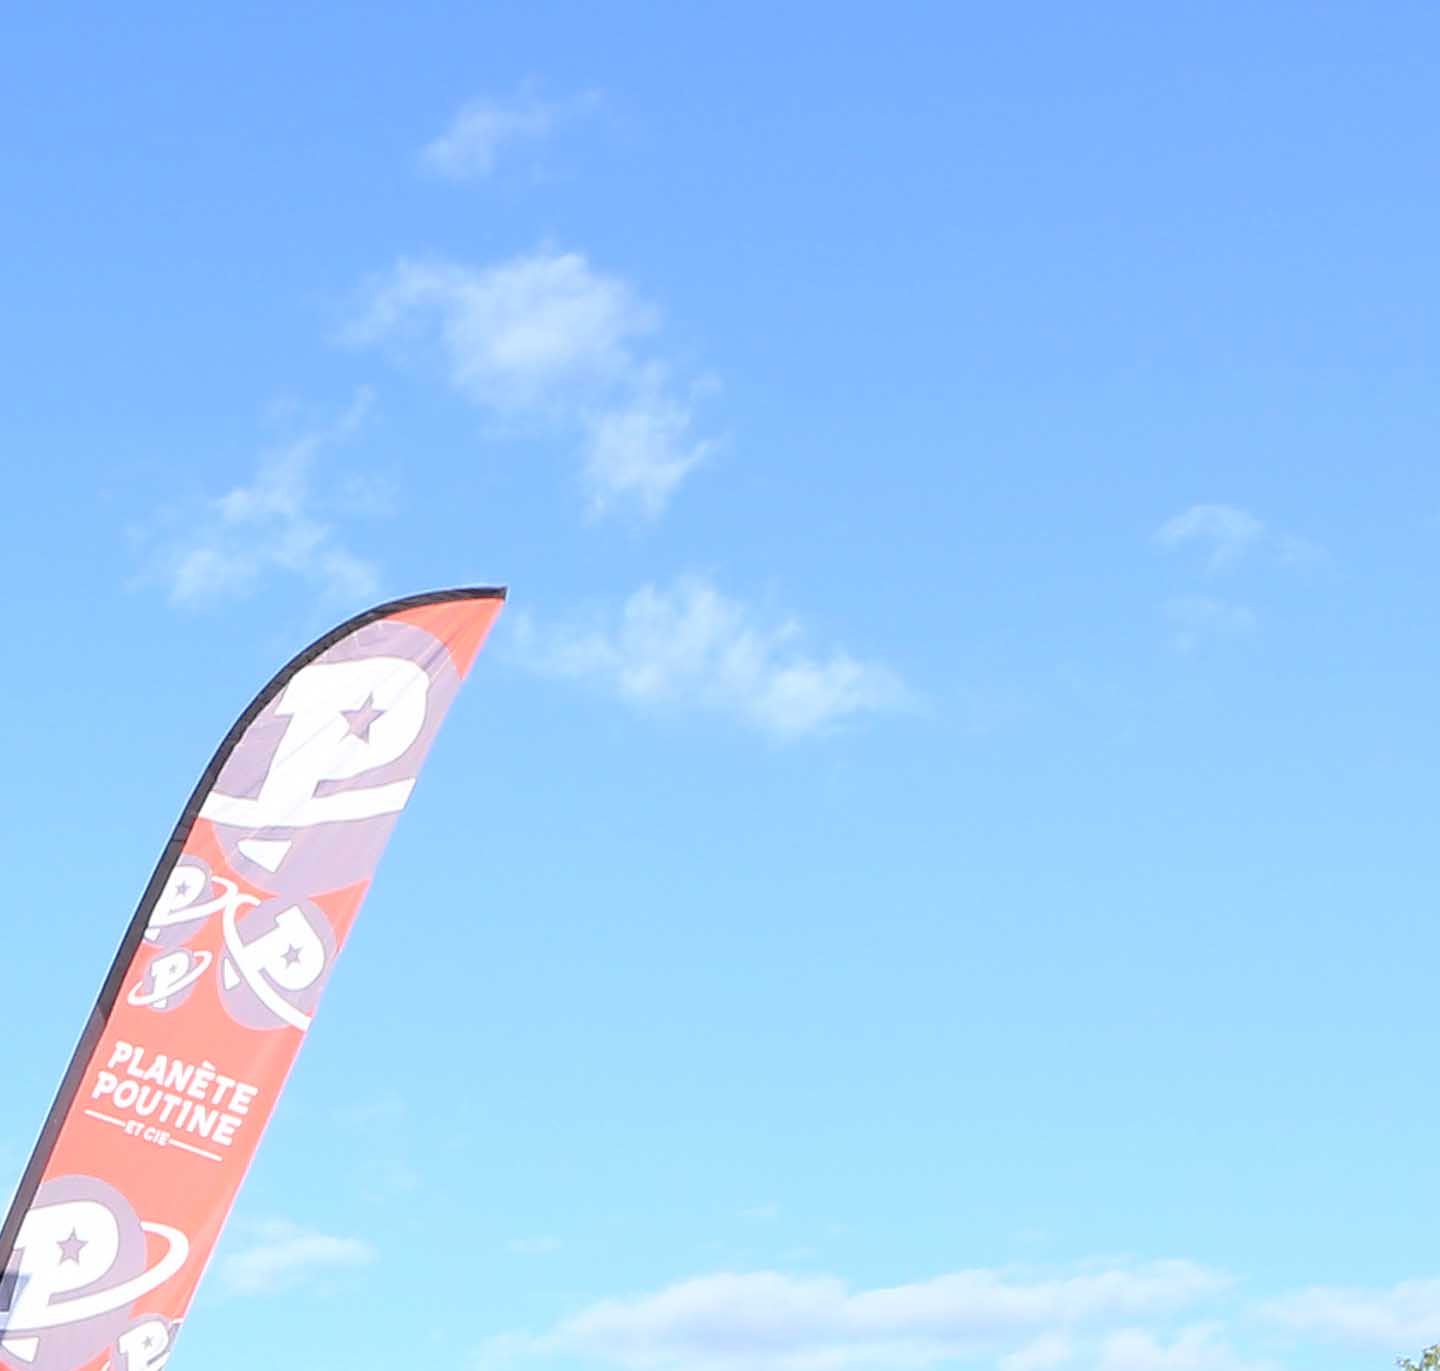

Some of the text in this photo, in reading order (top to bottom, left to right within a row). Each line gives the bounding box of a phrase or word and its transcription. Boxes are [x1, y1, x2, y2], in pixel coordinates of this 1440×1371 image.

[91, 1071, 242, 1146] POUTINE
[107, 1040, 258, 1115] PLANÈTE
[124, 1119, 170, 1146] ET CIE
